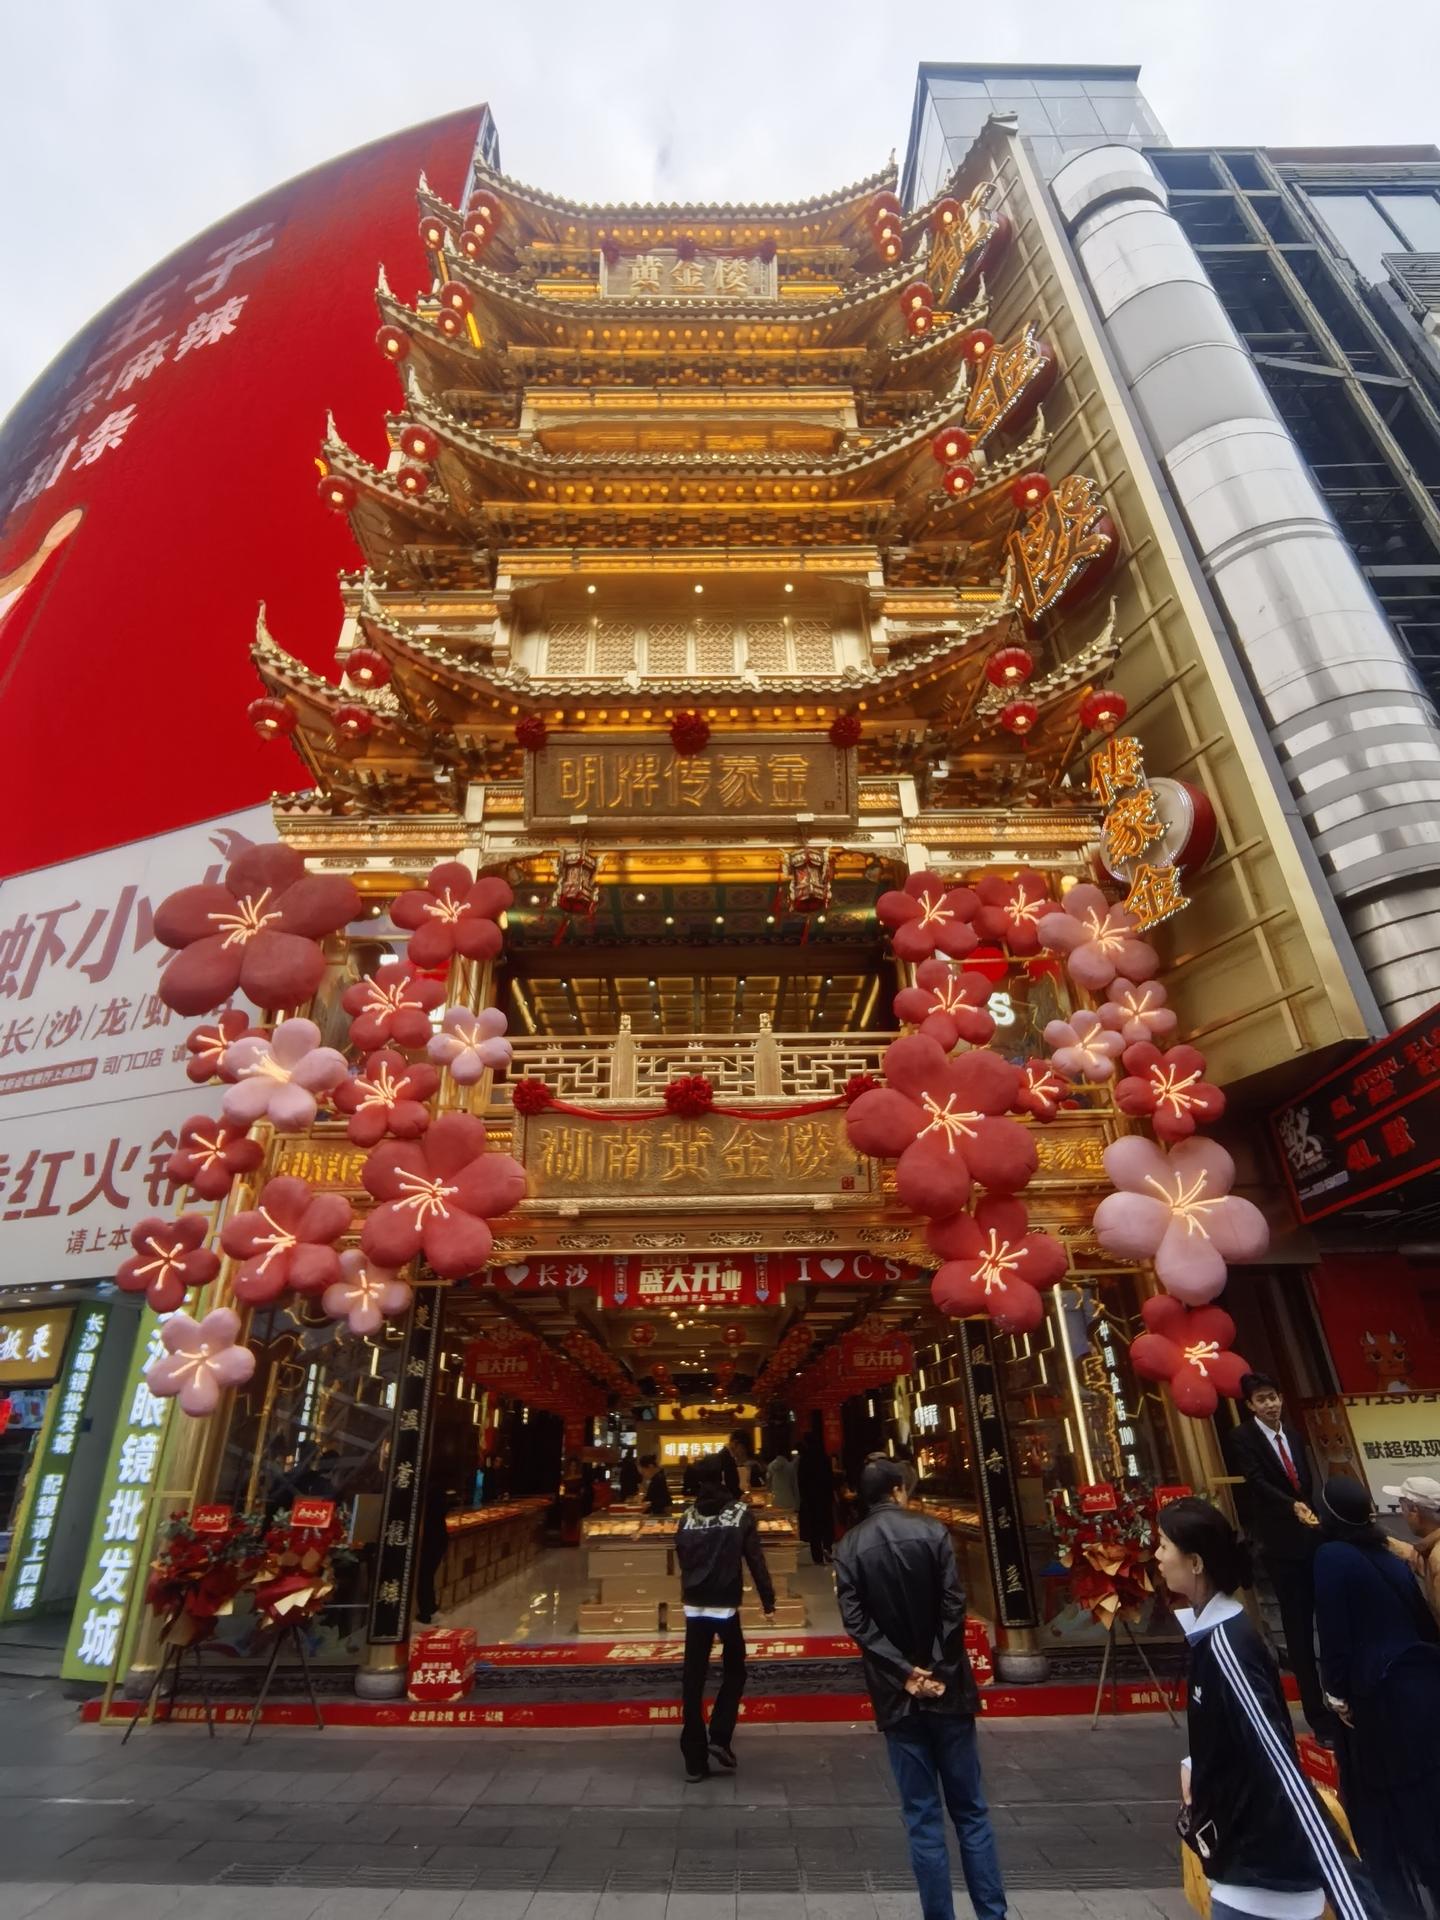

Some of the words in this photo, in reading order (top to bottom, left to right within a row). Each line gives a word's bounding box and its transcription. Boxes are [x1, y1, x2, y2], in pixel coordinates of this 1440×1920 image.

[102, 1048, 164, 1075] 司门口店
[538, 1121, 836, 1181] 湖南黄金楼
[535, 1263, 590, 1287] 长沙
[638, 1262, 742, 1294] 盛大开业
[52, 1313, 104, 1455] 长沙眼镜批发城
